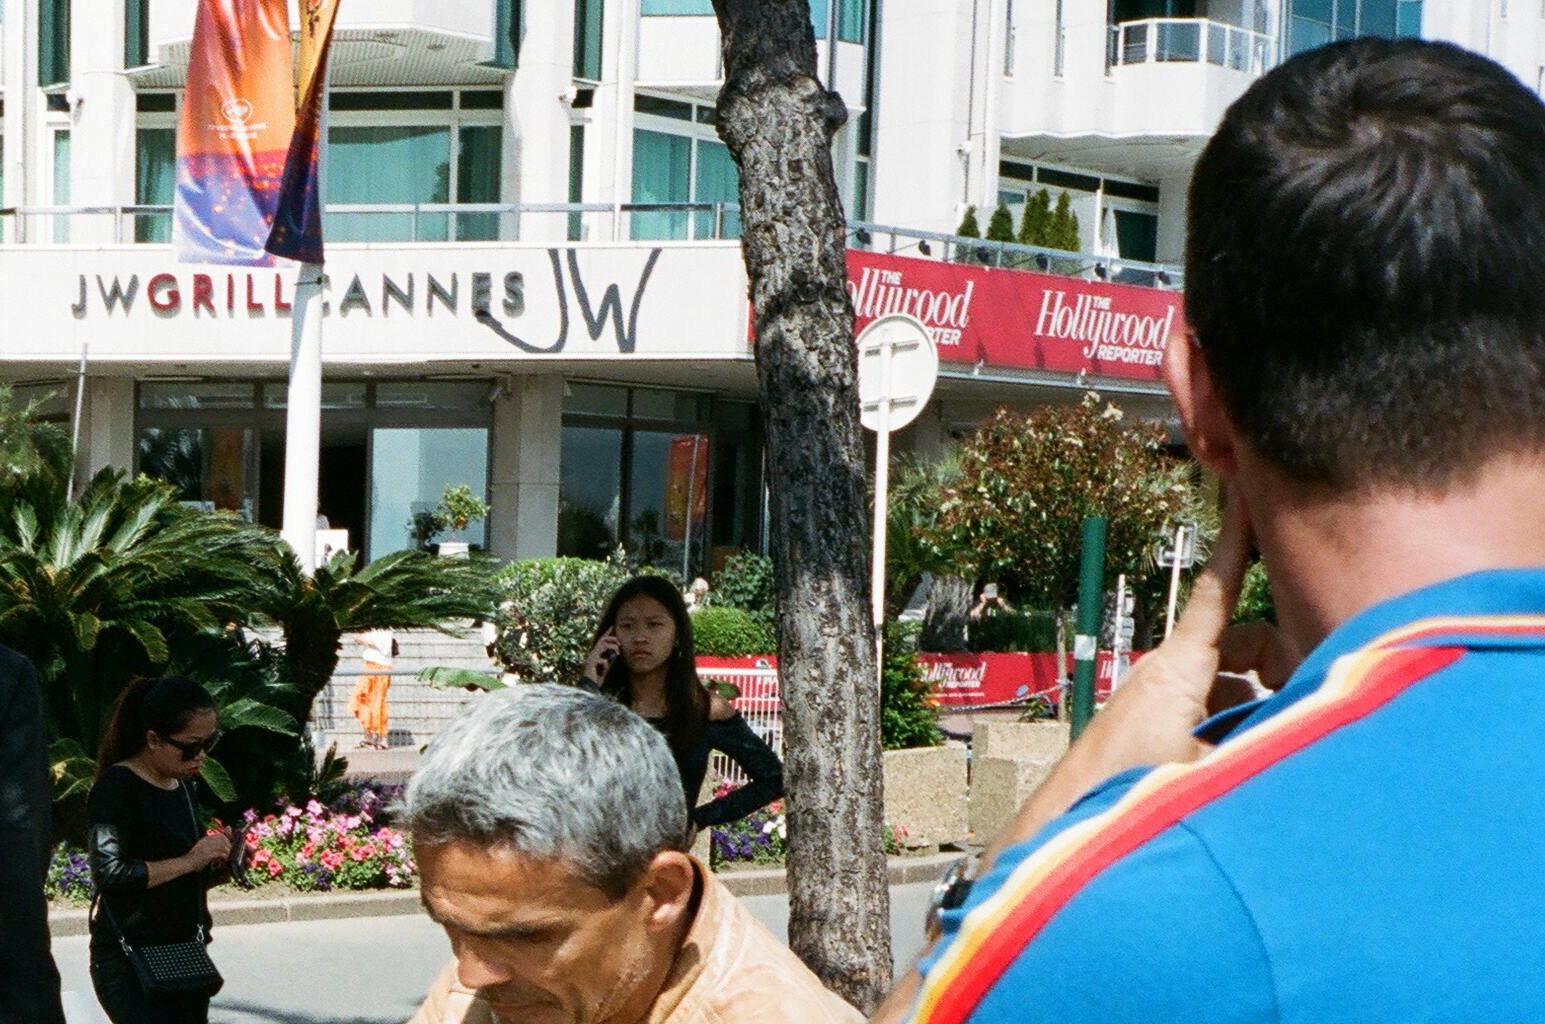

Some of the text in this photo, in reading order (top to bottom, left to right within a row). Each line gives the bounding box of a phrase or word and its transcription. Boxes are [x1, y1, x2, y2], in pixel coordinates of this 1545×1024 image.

[846, 267, 975, 328] ollywood
[880, 269, 903, 285] THE
[469, 248, 663, 353] JW
[1093, 295, 1112, 309] THE
[1034, 289, 1175, 359] Hollywood
[1097, 344, 1164, 366] REPORTER
